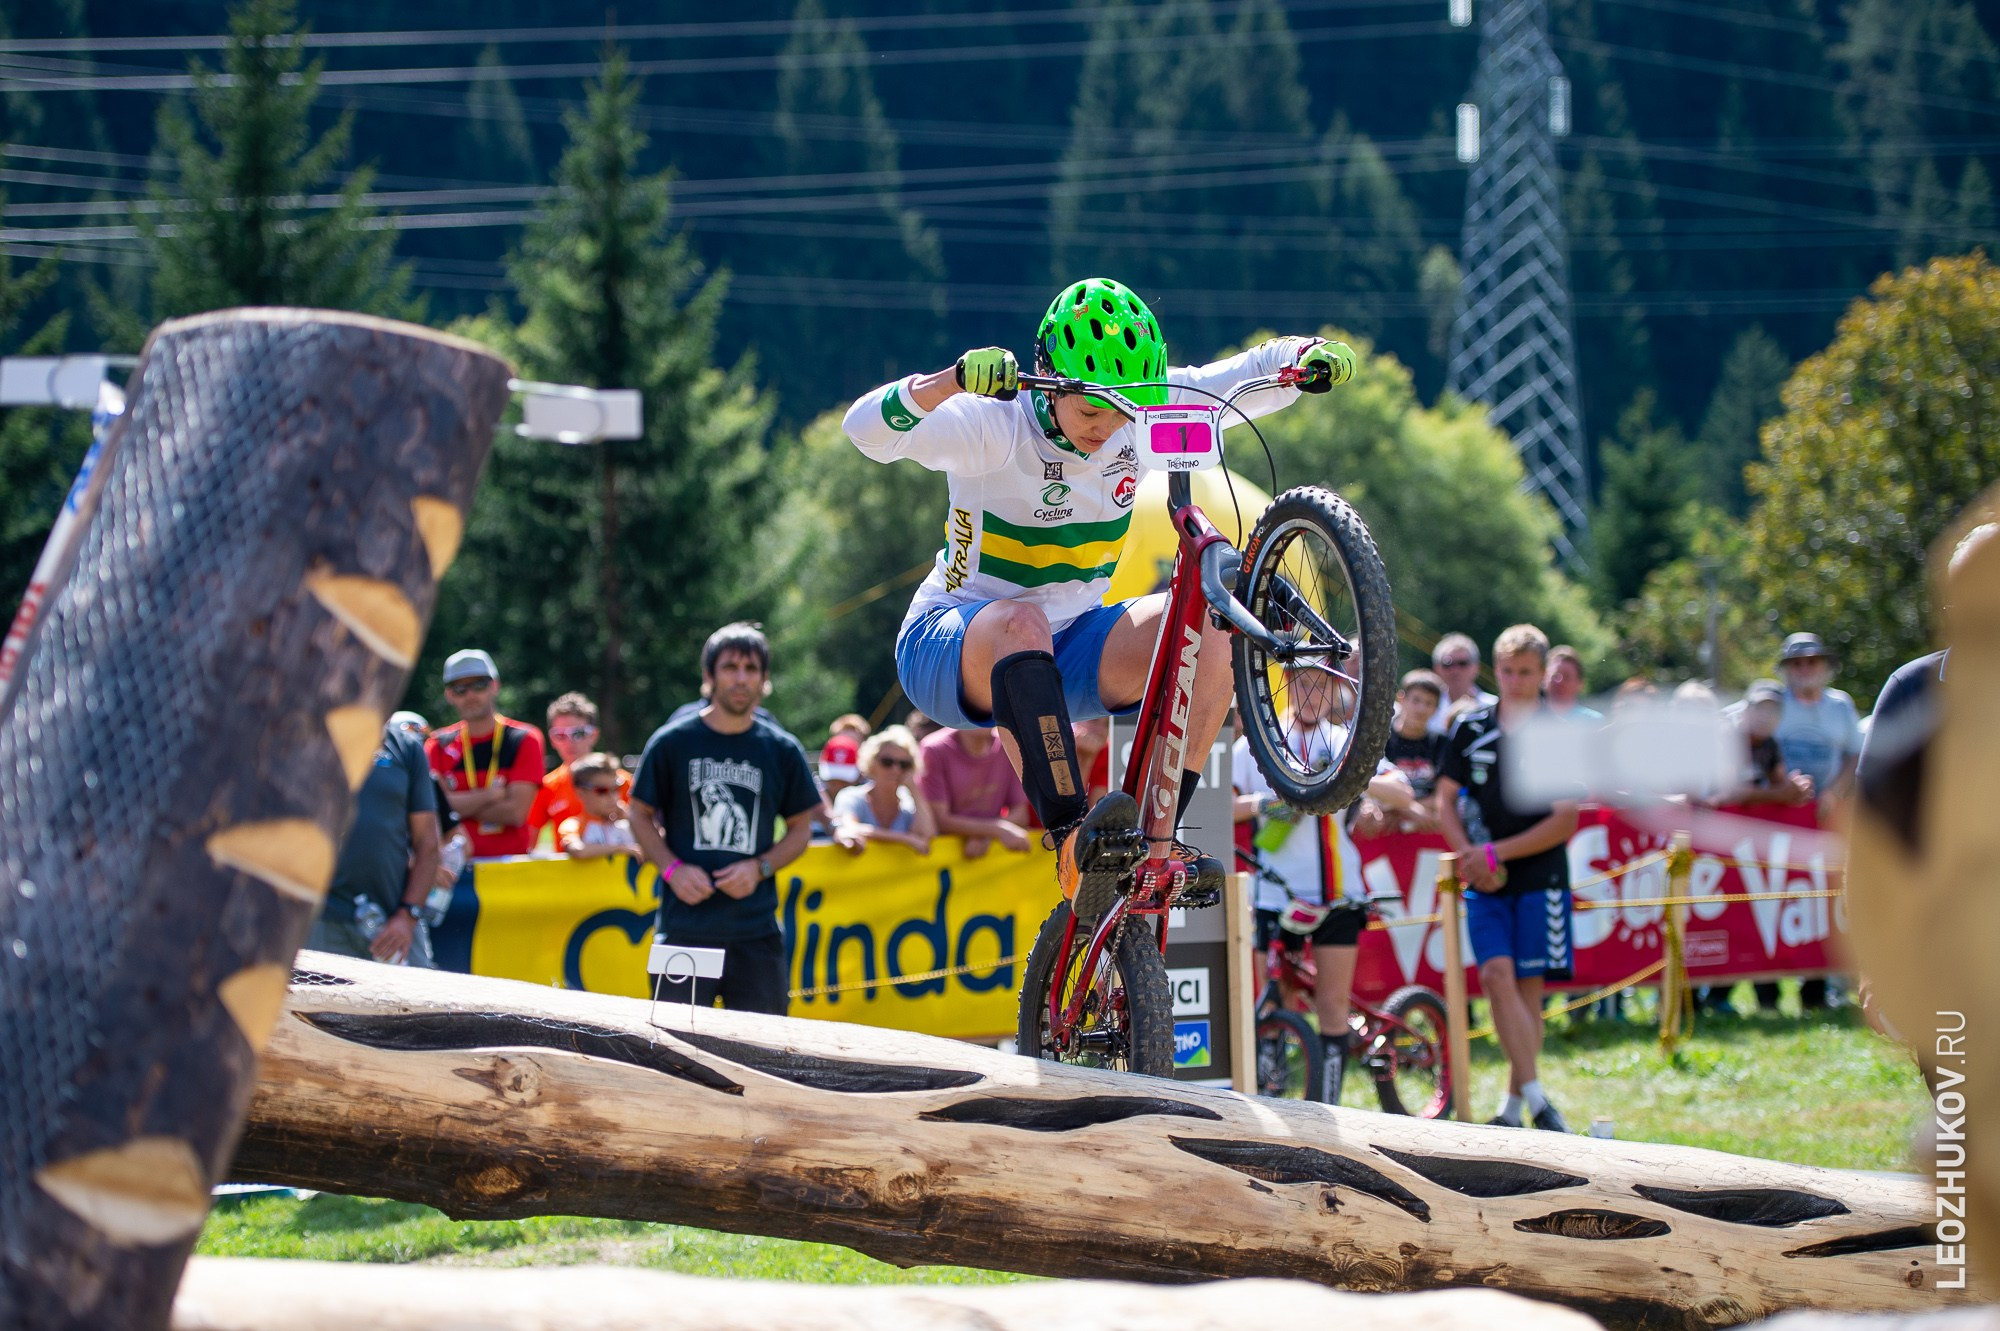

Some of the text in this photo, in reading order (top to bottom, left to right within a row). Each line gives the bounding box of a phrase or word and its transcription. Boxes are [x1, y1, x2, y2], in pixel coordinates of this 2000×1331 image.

[1177, 425, 1187, 451] 1
[1167, 457, 1200, 469] TRENTINO
[1033, 508, 1073, 520] Cycling
[1162, 624, 1202, 783] CLEAN
